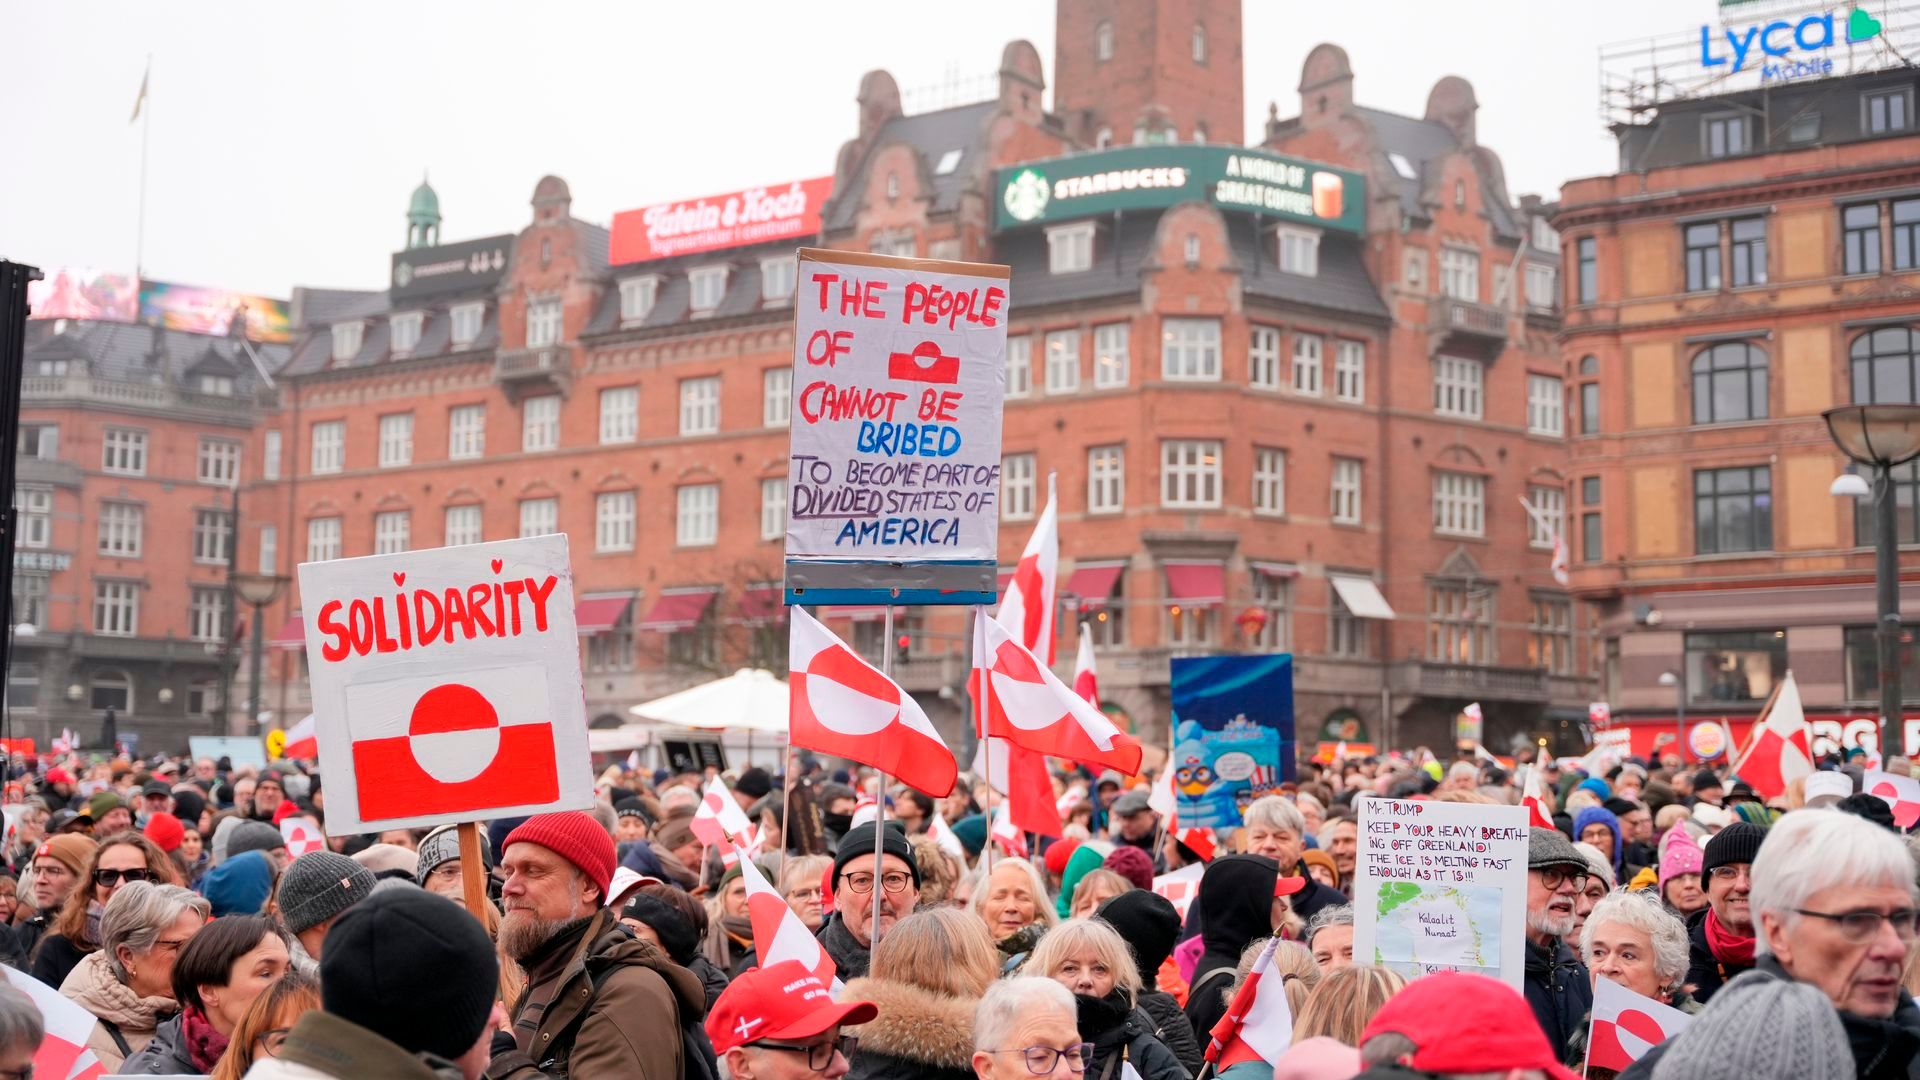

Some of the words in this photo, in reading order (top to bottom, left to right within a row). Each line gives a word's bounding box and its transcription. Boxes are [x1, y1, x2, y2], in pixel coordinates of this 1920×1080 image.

[1701, 12, 1834, 73] Lyca
[1761, 58, 1833, 82] Mobile
[1054, 167, 1186, 199] STARBUCKS
[1226, 155, 1240, 176] A
[1240, 156, 1287, 184] WORLD
[1287, 165, 1305, 188] OF
[1216, 180, 1265, 206] GREAT
[812, 274, 888, 318] THE
[902, 281, 1006, 330] PEOPLE
[806, 330, 854, 367] OF
[799, 381, 908, 424] CANNOT
[917, 388, 963, 422] BE
[857, 421, 962, 457] BRIBED
[791, 455, 832, 484] TO
[845, 458, 923, 486] BECOME
[922, 463, 974, 488] PART
[973, 464, 1000, 487] OF
[885, 490, 963, 514] STATES
[964, 492, 994, 514] OF
[835, 517, 960, 546] AMERICA
[1367, 801, 1384, 815] Mr.
[1385, 801, 1423, 816] TRUMP
[1367, 820, 1401, 835] KEEP
[1404, 823, 1434, 837] YOUR
[1438, 825, 1477, 838] HEAVY
[1481, 826, 1528, 841] BREATH-
[1391, 839, 1413, 850] OFF
[1418, 839, 1491, 853] GREENLAND!
[1367, 853, 1391, 864] THE
[1434, 856, 1479, 868] MELTING
[1483, 858, 1512, 870] FAST
[1369, 866, 1411, 879] ENOUGH
[1415, 869, 1431, 880] AS
[783, 978, 807, 993] MAKE
